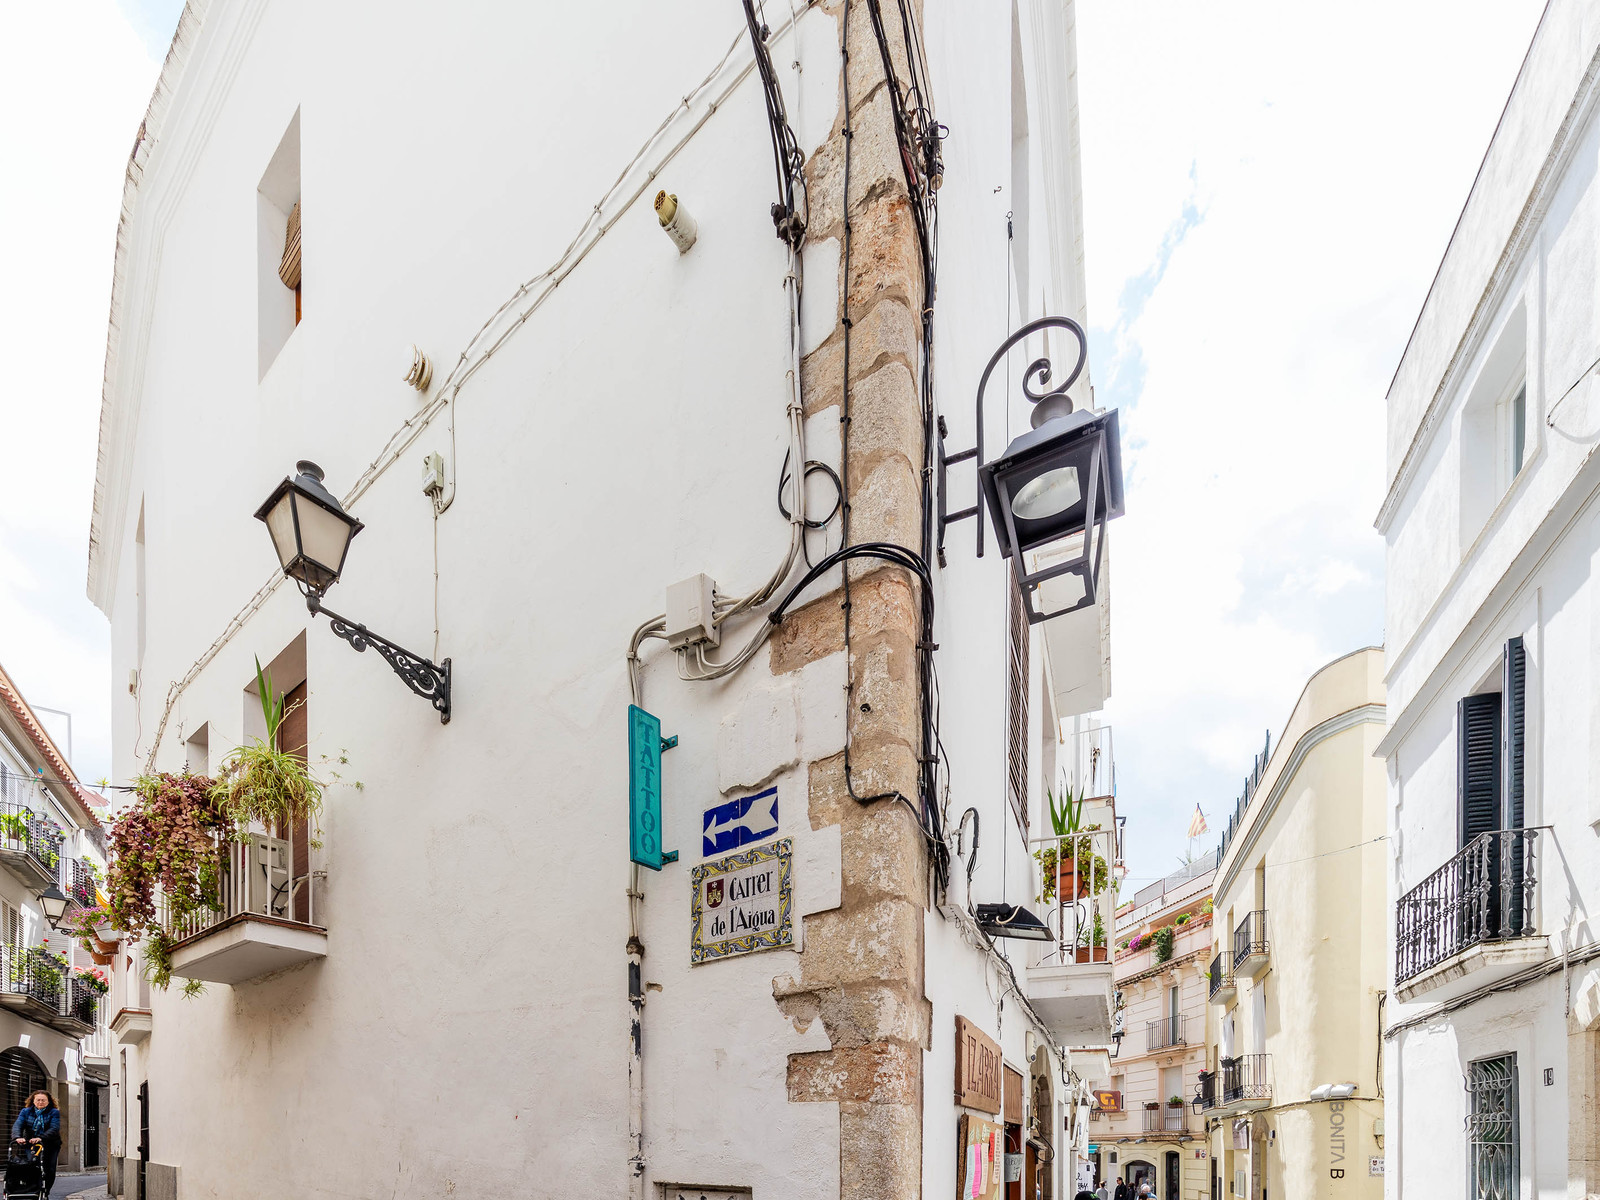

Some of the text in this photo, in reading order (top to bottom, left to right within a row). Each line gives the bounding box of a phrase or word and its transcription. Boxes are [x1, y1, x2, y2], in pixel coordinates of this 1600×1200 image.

[640, 722, 656, 855] TATTOO
[711, 906, 775, 937] de l'Aigua
[967, 1034, 999, 1101] IZARRA
[1544, 1069, 1554, 1086] 19
